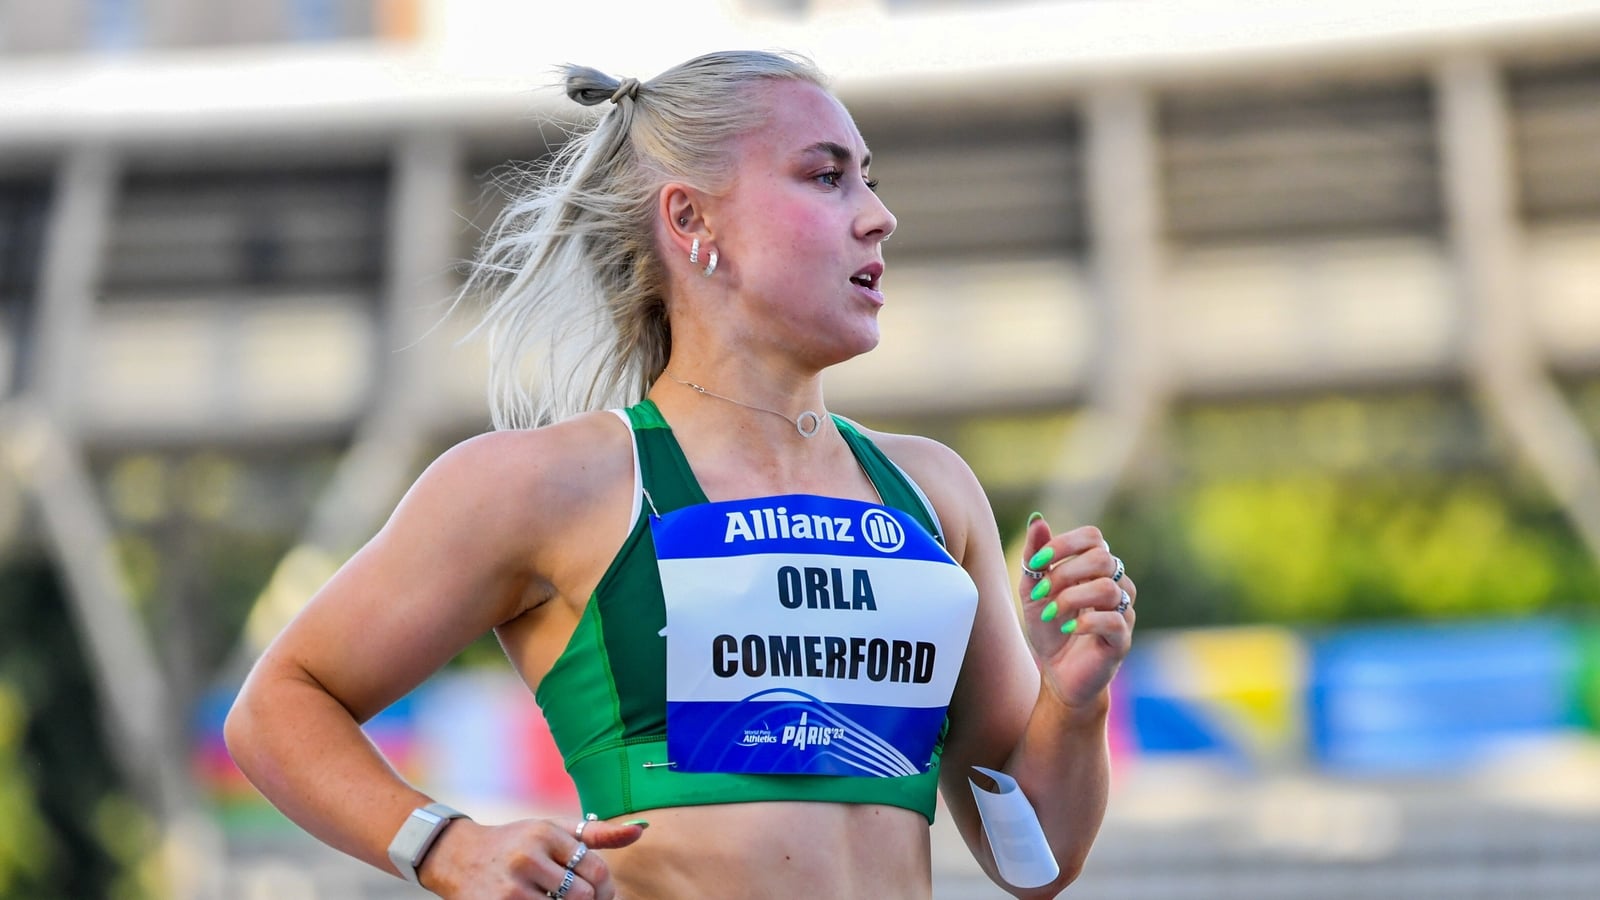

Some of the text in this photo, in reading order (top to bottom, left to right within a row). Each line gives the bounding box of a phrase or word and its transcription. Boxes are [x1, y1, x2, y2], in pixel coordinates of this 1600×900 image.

[724, 507, 855, 543] Allianz
[777, 566, 877, 611] ORLA
[712, 634, 936, 683] COMERFORD
[743, 734, 777, 743] Athletics
